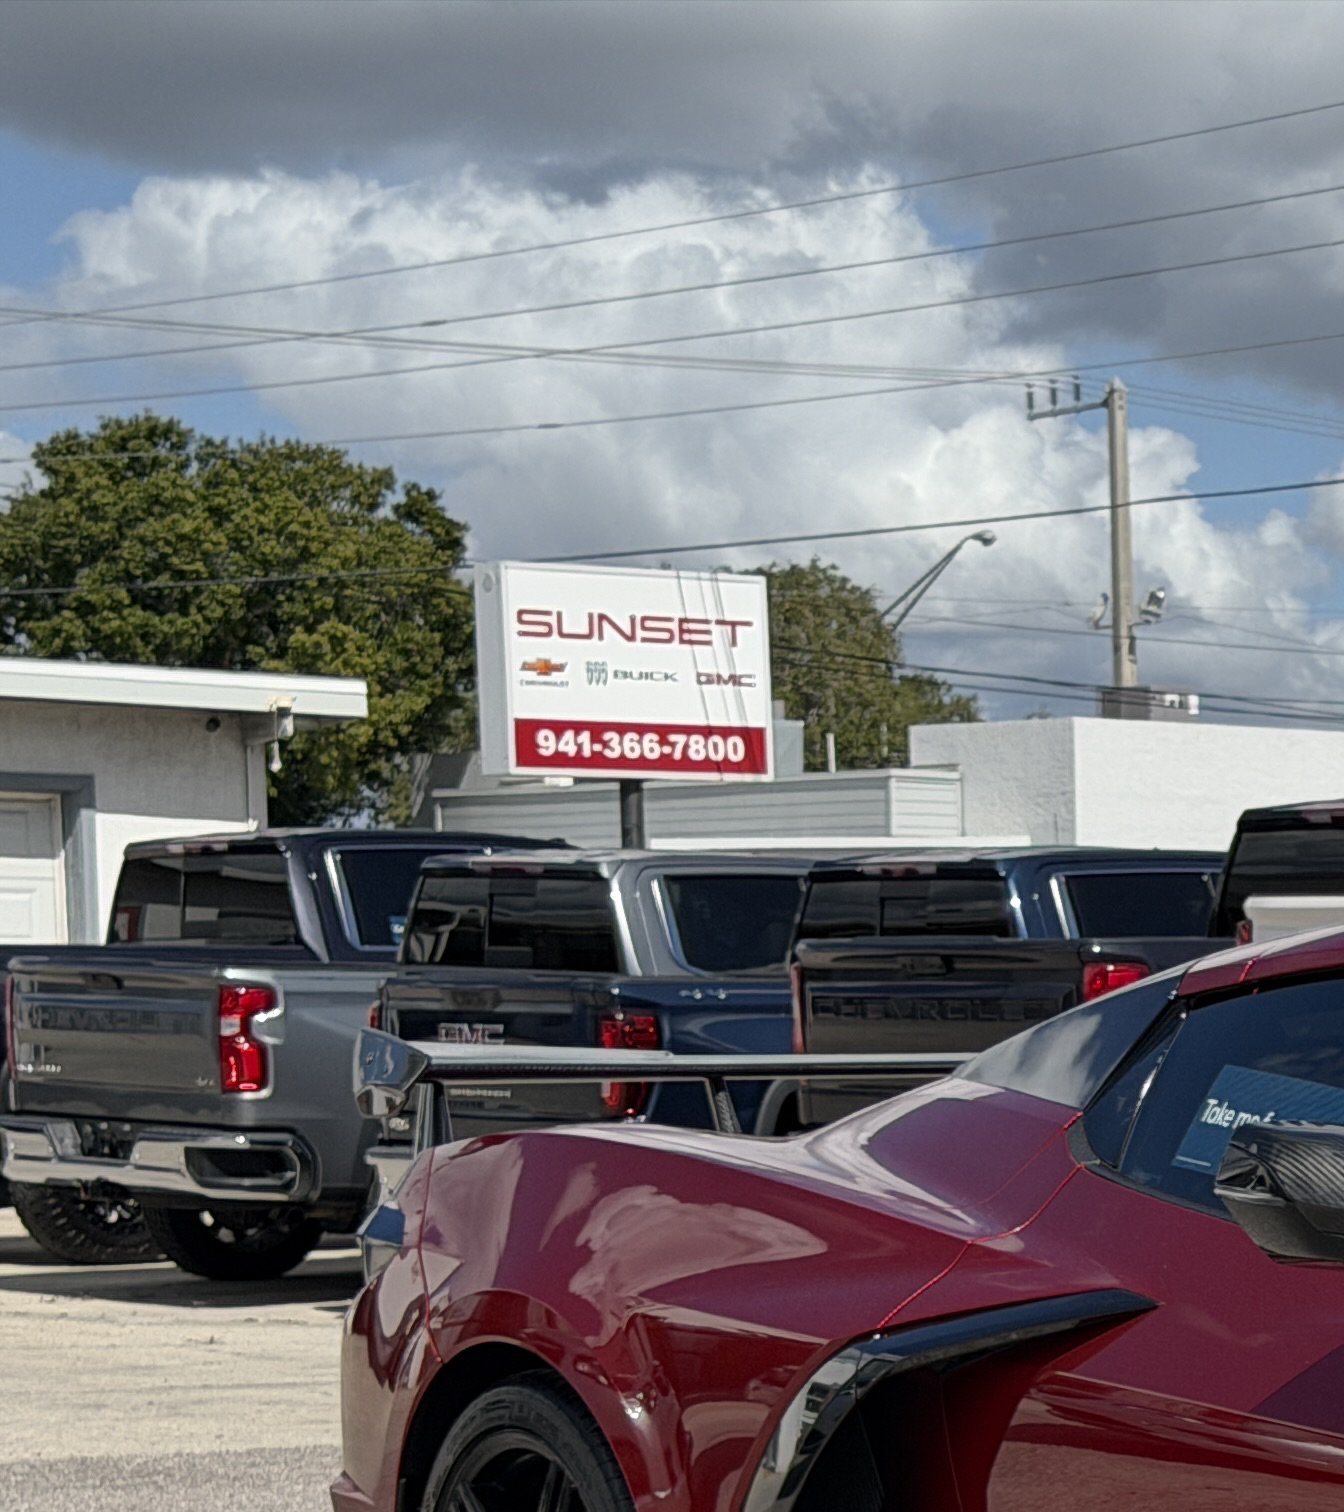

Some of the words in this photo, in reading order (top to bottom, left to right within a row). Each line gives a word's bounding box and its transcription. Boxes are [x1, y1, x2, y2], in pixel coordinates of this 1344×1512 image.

[516, 609, 754, 648] SUNSET
[612, 669, 679, 683] BUICK
[696, 671, 757, 688] GMC
[535, 728, 746, 763] 941-366-7800
[437, 1022, 505, 1045] GMC
[1200, 1098, 1236, 1128] Take
